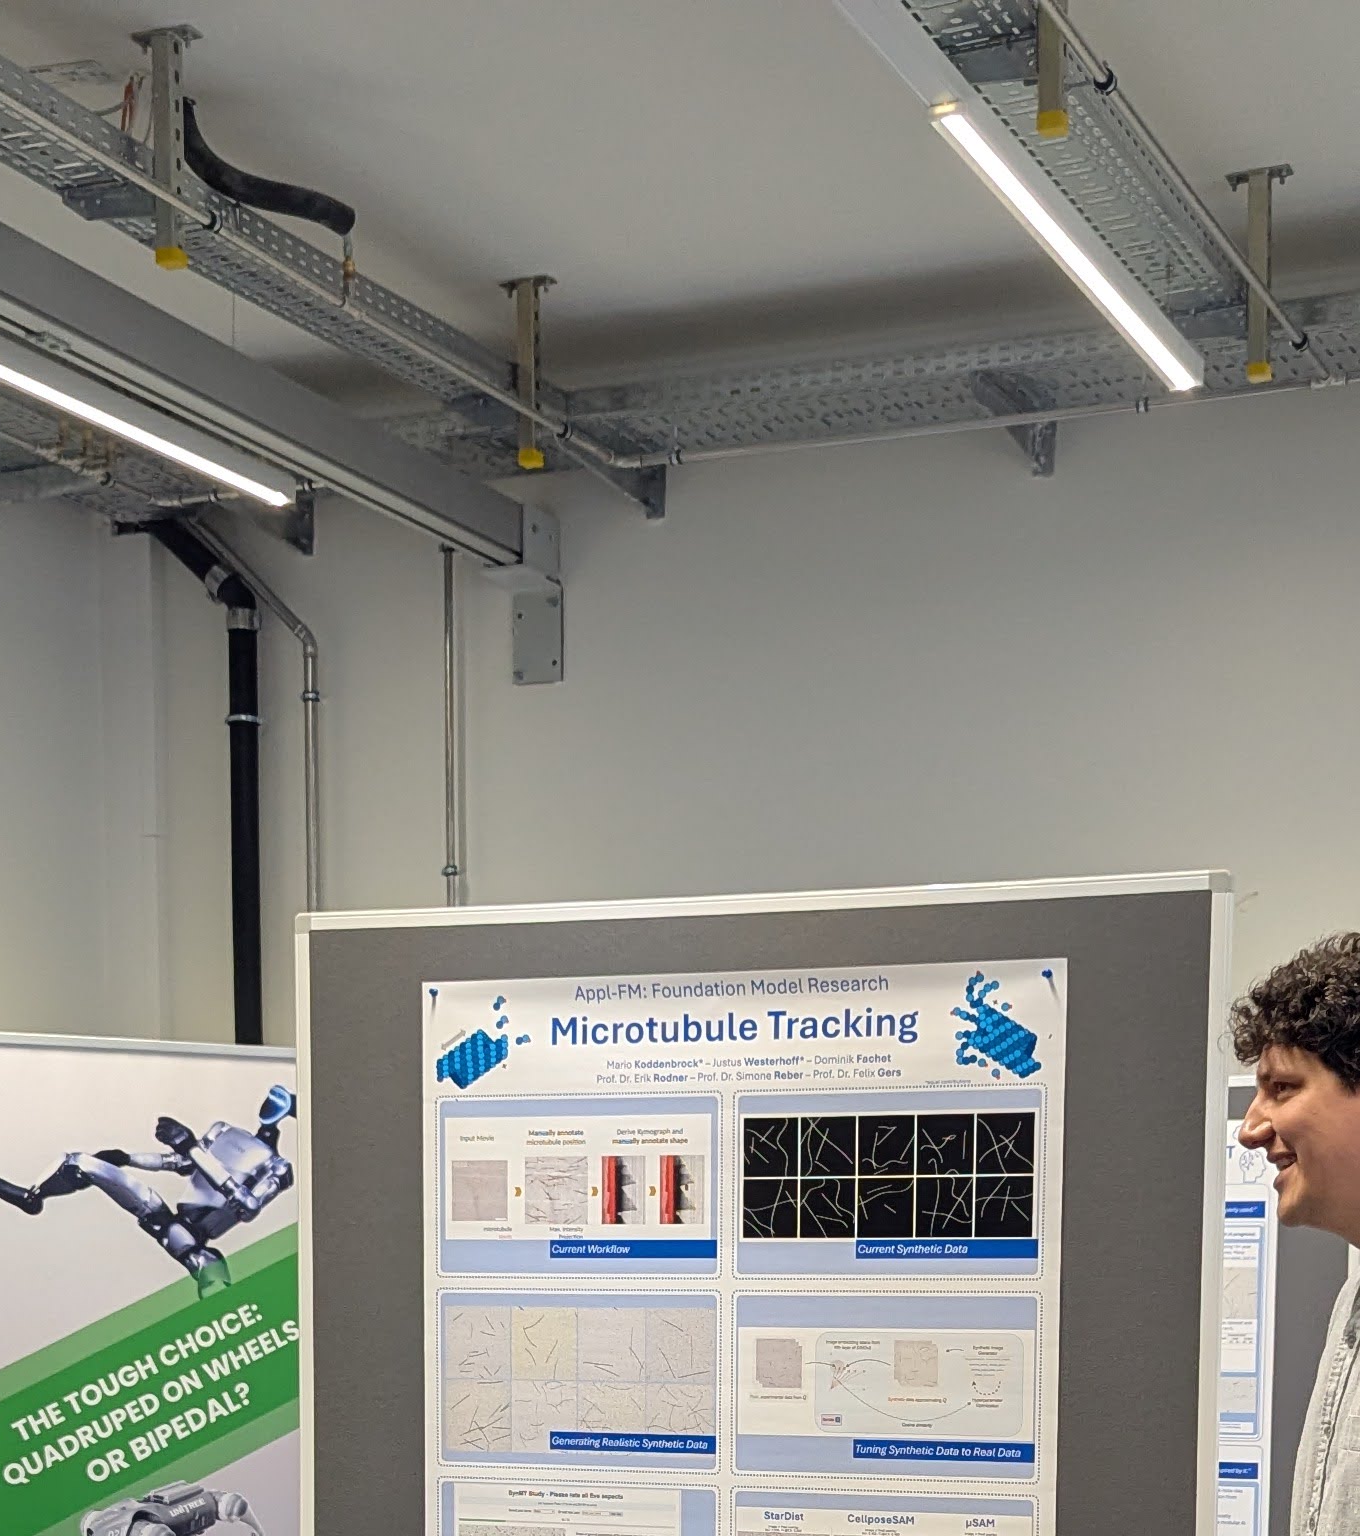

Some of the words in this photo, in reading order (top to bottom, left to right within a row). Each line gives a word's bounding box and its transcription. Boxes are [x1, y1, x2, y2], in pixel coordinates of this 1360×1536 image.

[574, 984, 648, 1004] Appl-FM:
[652, 980, 747, 999] Foundation
[751, 977, 803, 996] Model
[808, 976, 889, 993] Research
[551, 1012, 758, 1046] Microtubule
[767, 1007, 919, 1044] Tracking
[607, 1059, 632, 1070] Mario
[712, 1058, 742, 1068] Justus
[814, 1054, 854, 1065] Dominik
[856, 1054, 891, 1064] Fachet
[597, 1074, 616, 1084] Prof.
[619, 1073, 631, 1083] Dr.
[634, 1073, 652, 1083] Erik
[653, 1072, 688, 1083] Rodner
[697, 1072, 718, 1082] Prof.
[721, 1072, 734, 1081] Dr.
[736, 1070, 771, 1081] Simone
[774, 1069, 803, 1080] Reber
[813, 1068, 834, 1078] Prof.
[837, 1068, 850, 1078] Dr.
[853, 1068, 875, 1078] Felix
[877, 1068, 902, 1078] Gers
[528, 1129, 556, 1137] Manually
[526, 1138, 561, 1146] microtubule
[562, 1138, 586, 1146] position
[670, 1137, 688, 1145] shape
[552, 1244, 586, 1254] Current
[587, 1244, 630, 1254] Workflow
[858, 1244, 895, 1254] Current
[897, 1244, 942, 1255] Synthetic
[944, 1244, 968, 1254] Data
[11, 1401, 66, 1441] THE
[63, 1354, 159, 1414] TOUGH
[159, 1304, 263, 1367] CHOICE:
[3, 1393, 160, 1485] QUADRUPED
[162, 1369, 204, 1403] ON
[202, 1320, 300, 1381] WHEELS
[86, 1447, 131, 1482] OR
[128, 1382, 250, 1462] BIPEDAL?
[551, 1435, 600, 1448] Generating
[602, 1438, 640, 1448] Realistic
[642, 1438, 684, 1451] Synthetic
[686, 1440, 708, 1450] Data
[855, 1444, 887, 1457] Tuning
[889, 1445, 934, 1459] Synthetic
[936, 1446, 960, 1457] Data
[961, 1448, 971, 1457] to
[973, 1447, 995, 1457] Real
[997, 1448, 1021, 1458] Data
[764, 1511, 804, 1521] StarDist
[847, 1513, 915, 1526] CellposeSAM
